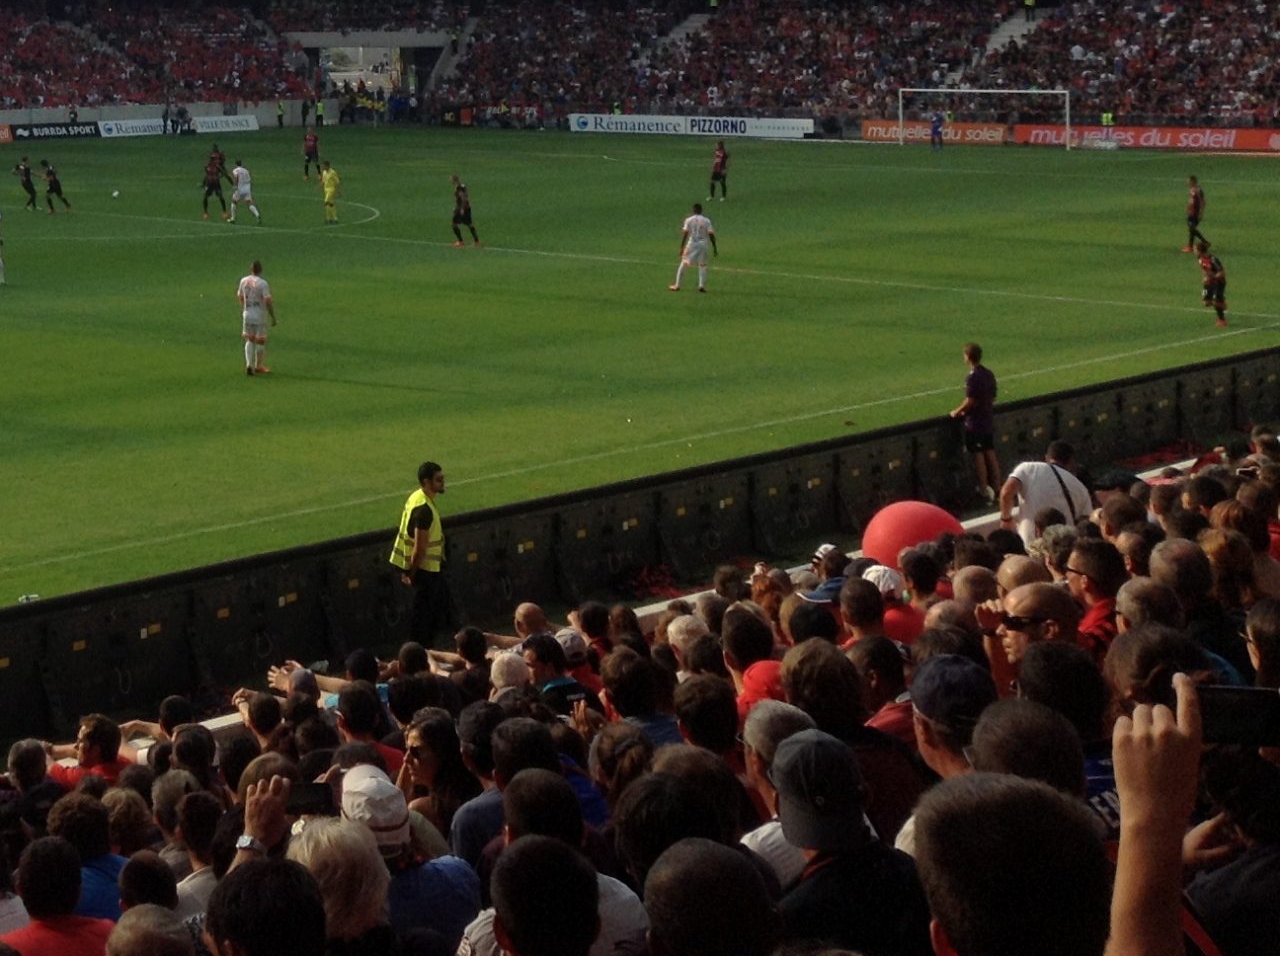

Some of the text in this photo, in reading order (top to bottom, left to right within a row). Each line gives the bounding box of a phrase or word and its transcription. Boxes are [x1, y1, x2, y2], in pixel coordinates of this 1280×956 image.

[33, 125, 96, 137] BURRDA SPORT
[593, 115, 681, 133] Rémanence
[690, 118, 747, 134] PIZZORNO
[942, 126, 961, 140] du
[966, 127, 1004, 142] soleil
[1140, 128, 1170, 147] du
[1177, 129, 1237, 148] soleil
